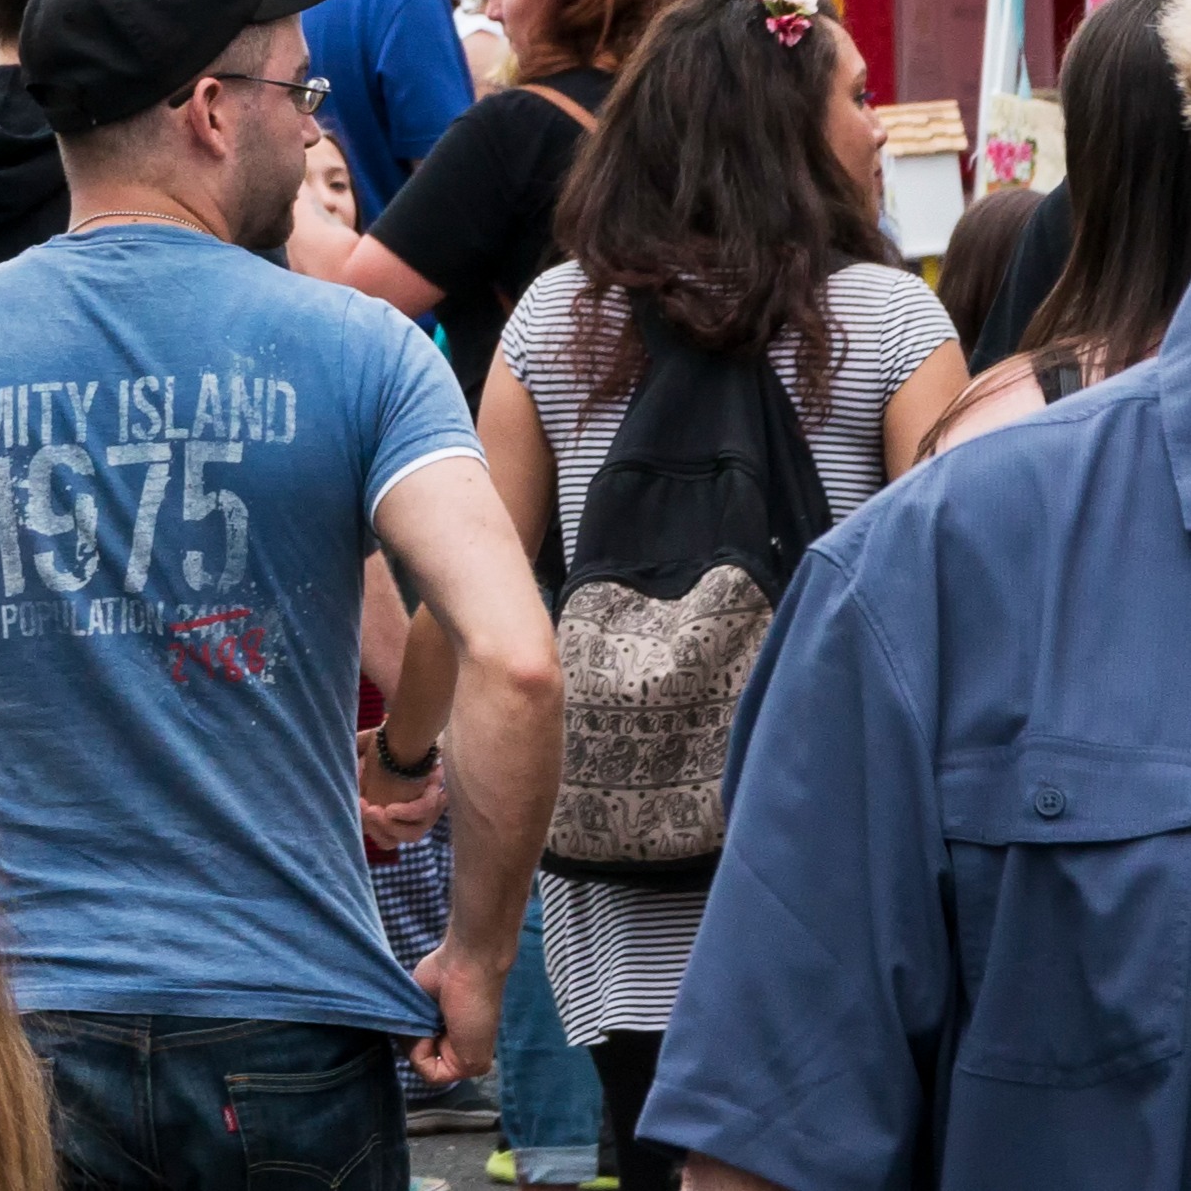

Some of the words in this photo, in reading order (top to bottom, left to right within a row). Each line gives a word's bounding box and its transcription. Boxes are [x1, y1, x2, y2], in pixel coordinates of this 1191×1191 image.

[117, 371, 298, 445] ISLAND
[0, 596, 165, 639] POPULATION
[168, 627, 267, 683] 2488
